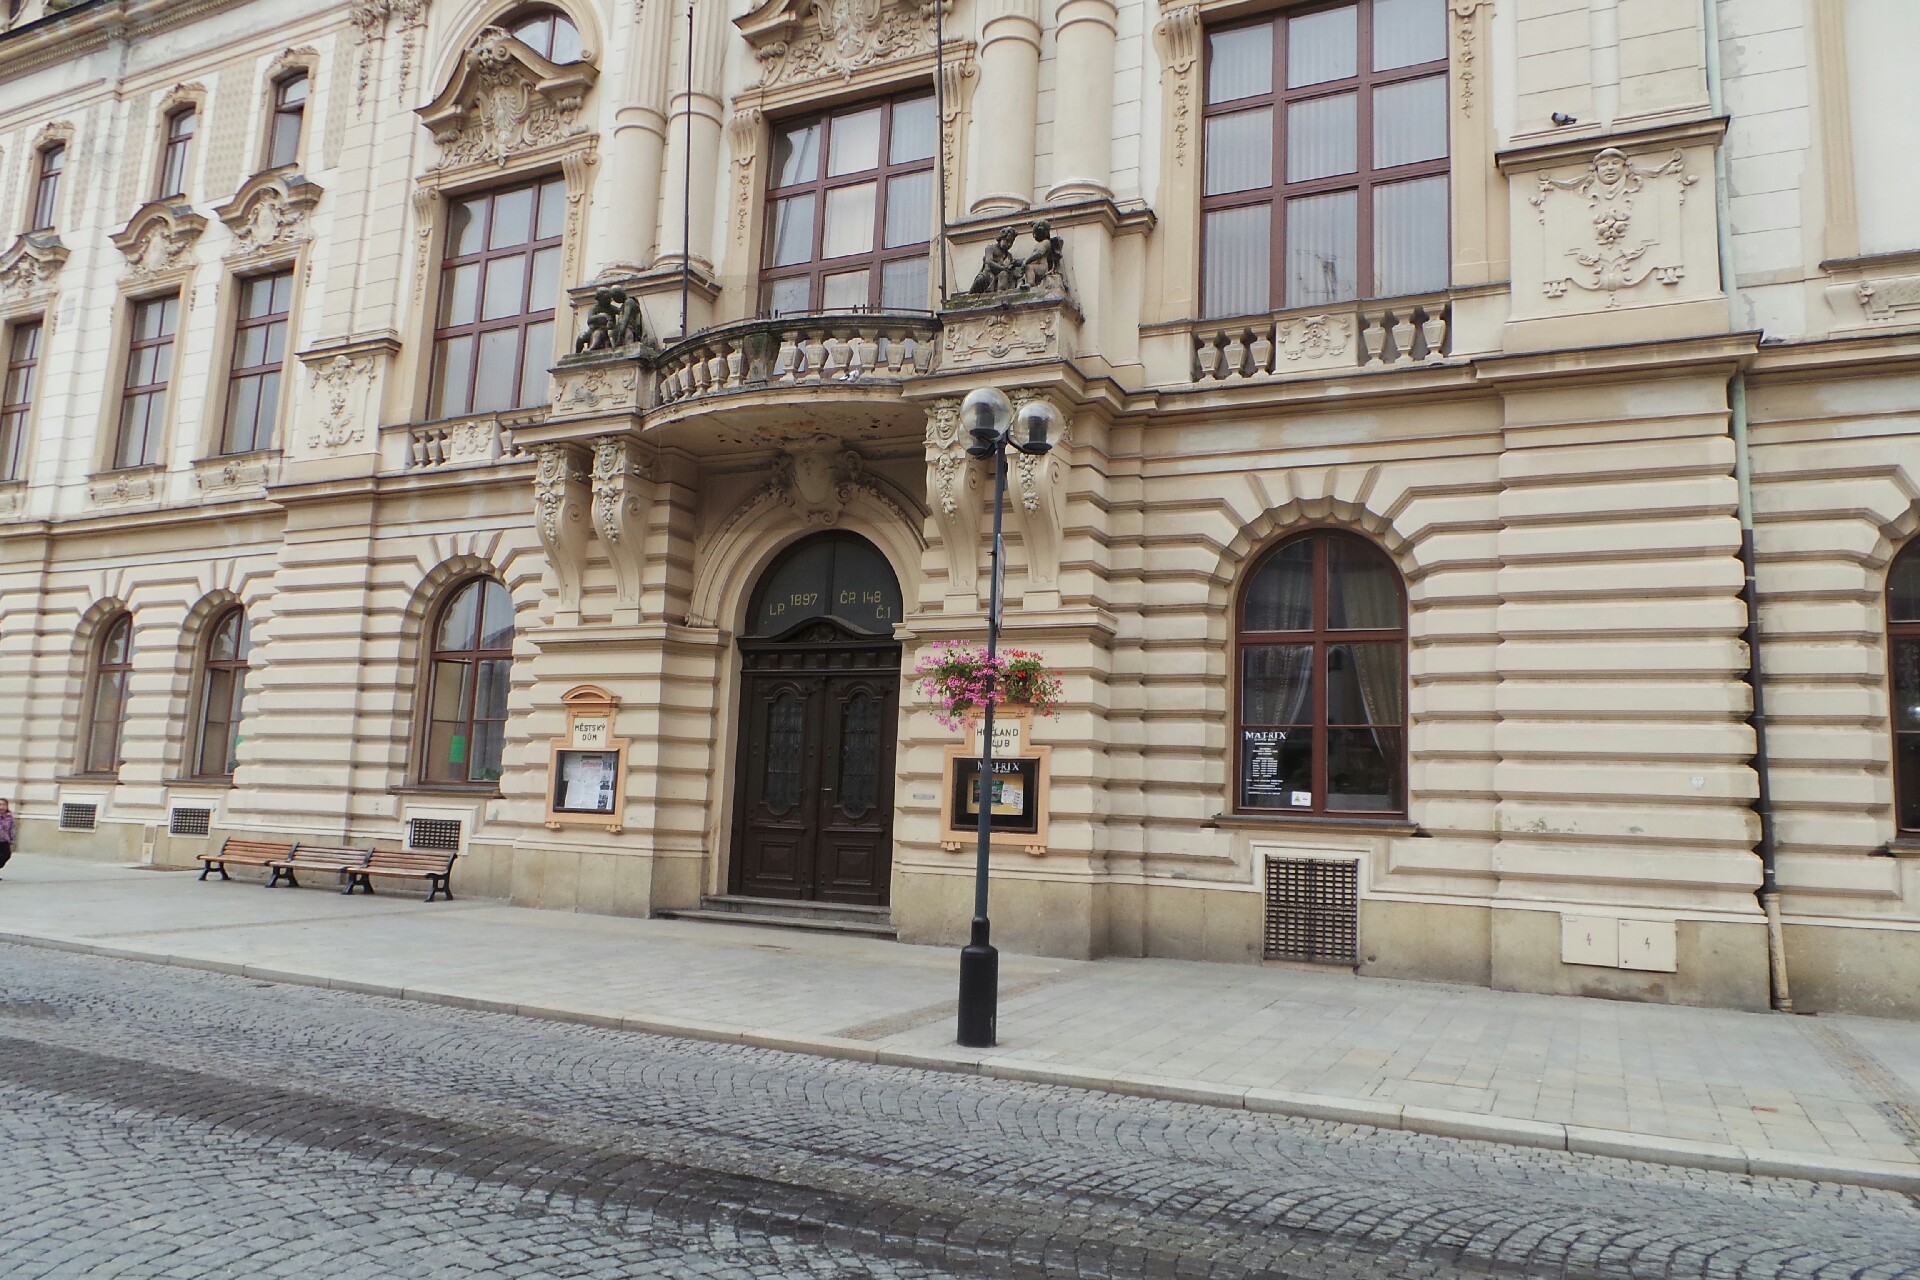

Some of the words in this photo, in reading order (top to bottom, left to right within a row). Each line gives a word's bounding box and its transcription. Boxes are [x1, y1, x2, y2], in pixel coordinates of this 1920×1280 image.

[790, 594, 818, 606] 1897
[862, 591, 880, 604] 148
[574, 722, 606, 732] MĚSTSKÝ
[976, 728, 1018, 736] HLAND
[1244, 732, 1286, 740] MATRIX
[582, 733, 597, 741] DŮM
[977, 761, 1020, 770] MTRIX
